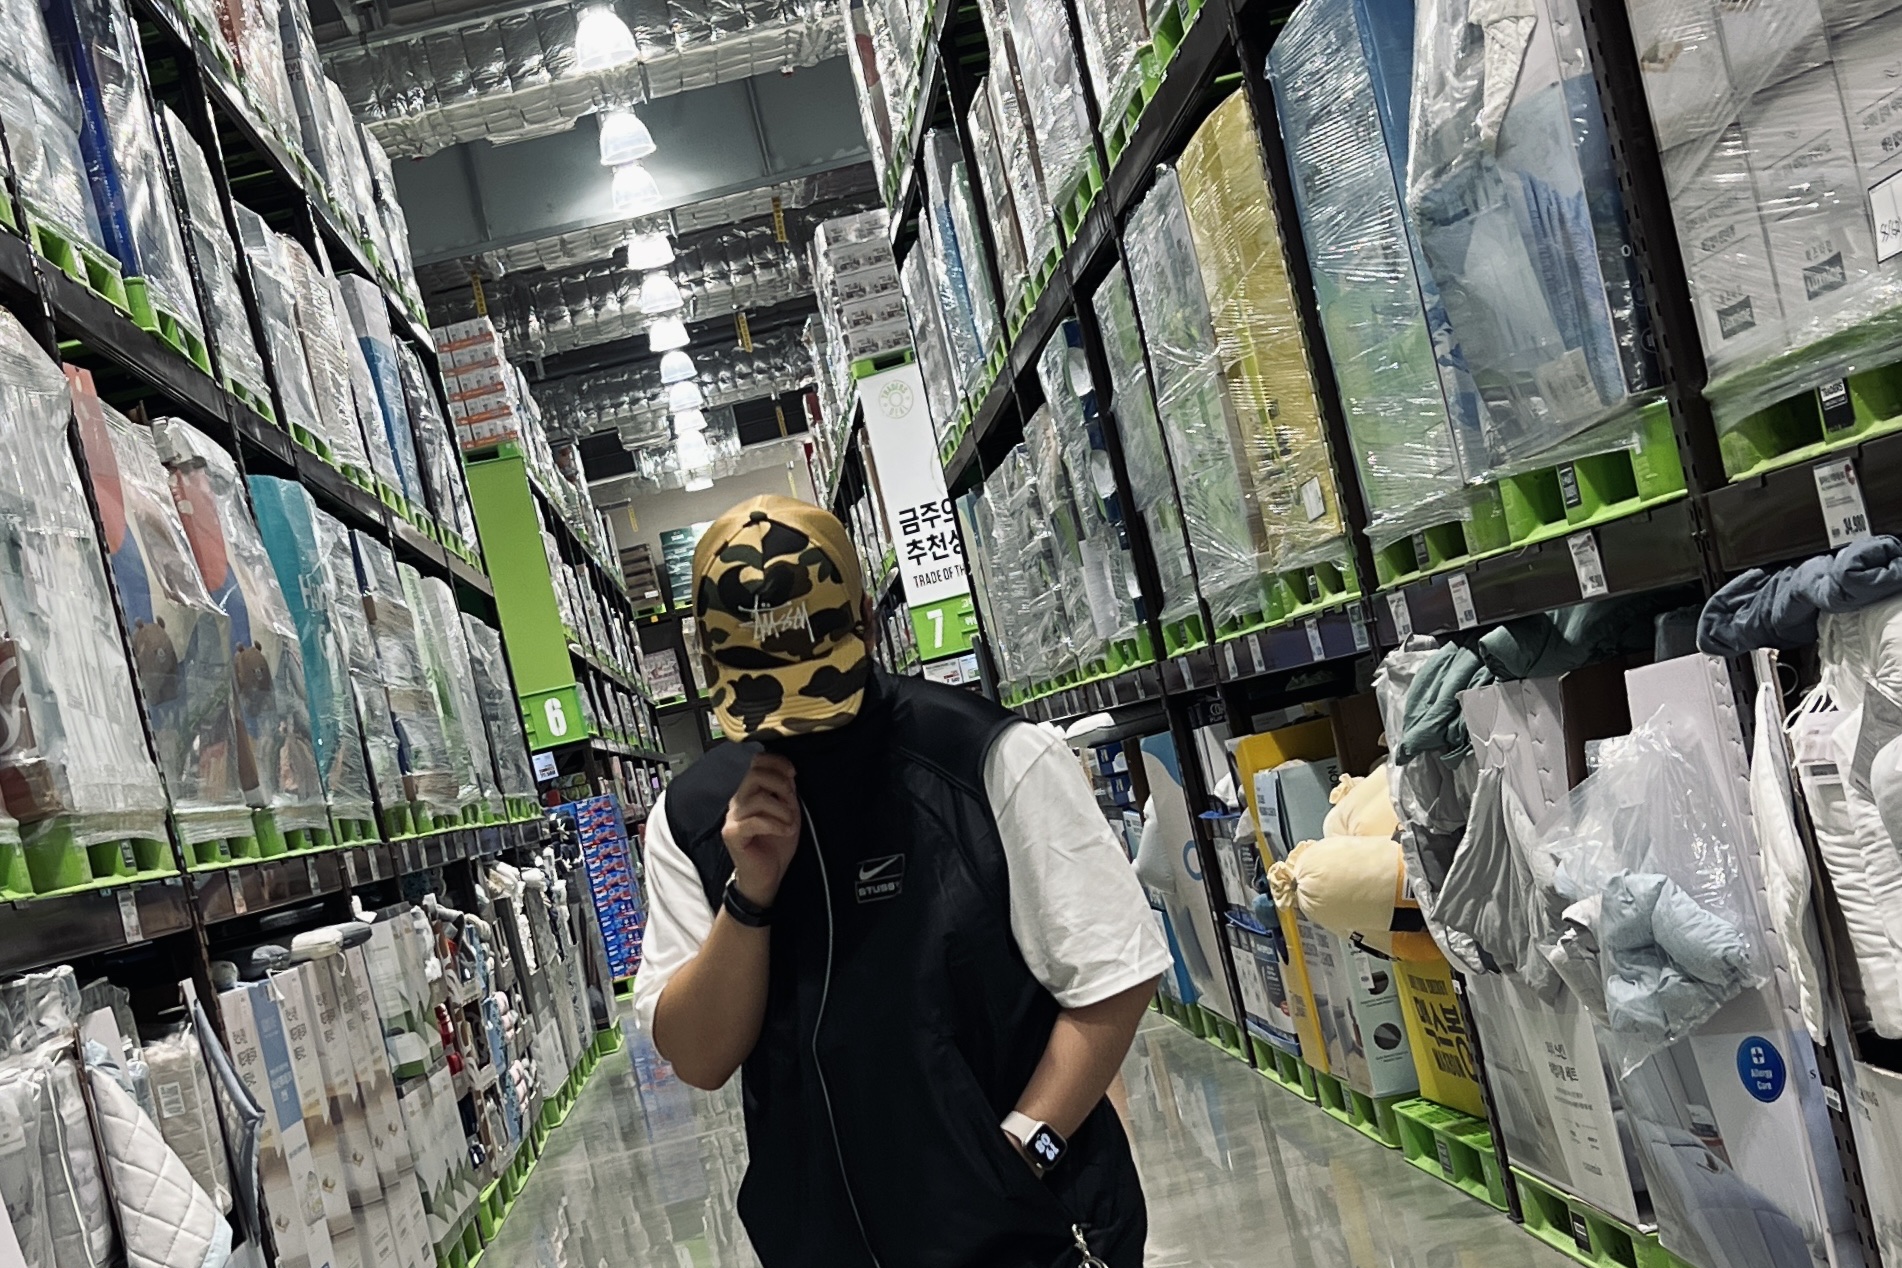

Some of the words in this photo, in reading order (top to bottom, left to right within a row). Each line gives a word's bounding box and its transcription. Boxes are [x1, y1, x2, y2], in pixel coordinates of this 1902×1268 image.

[913, 569, 942, 588] TRADE
[943, 567, 954, 580] OF
[926, 608, 943, 649] 7
[544, 697, 567, 736] 6
[1751, 1068, 1773, 1079] Allergy
[1756, 1081, 1772, 1090] Care
